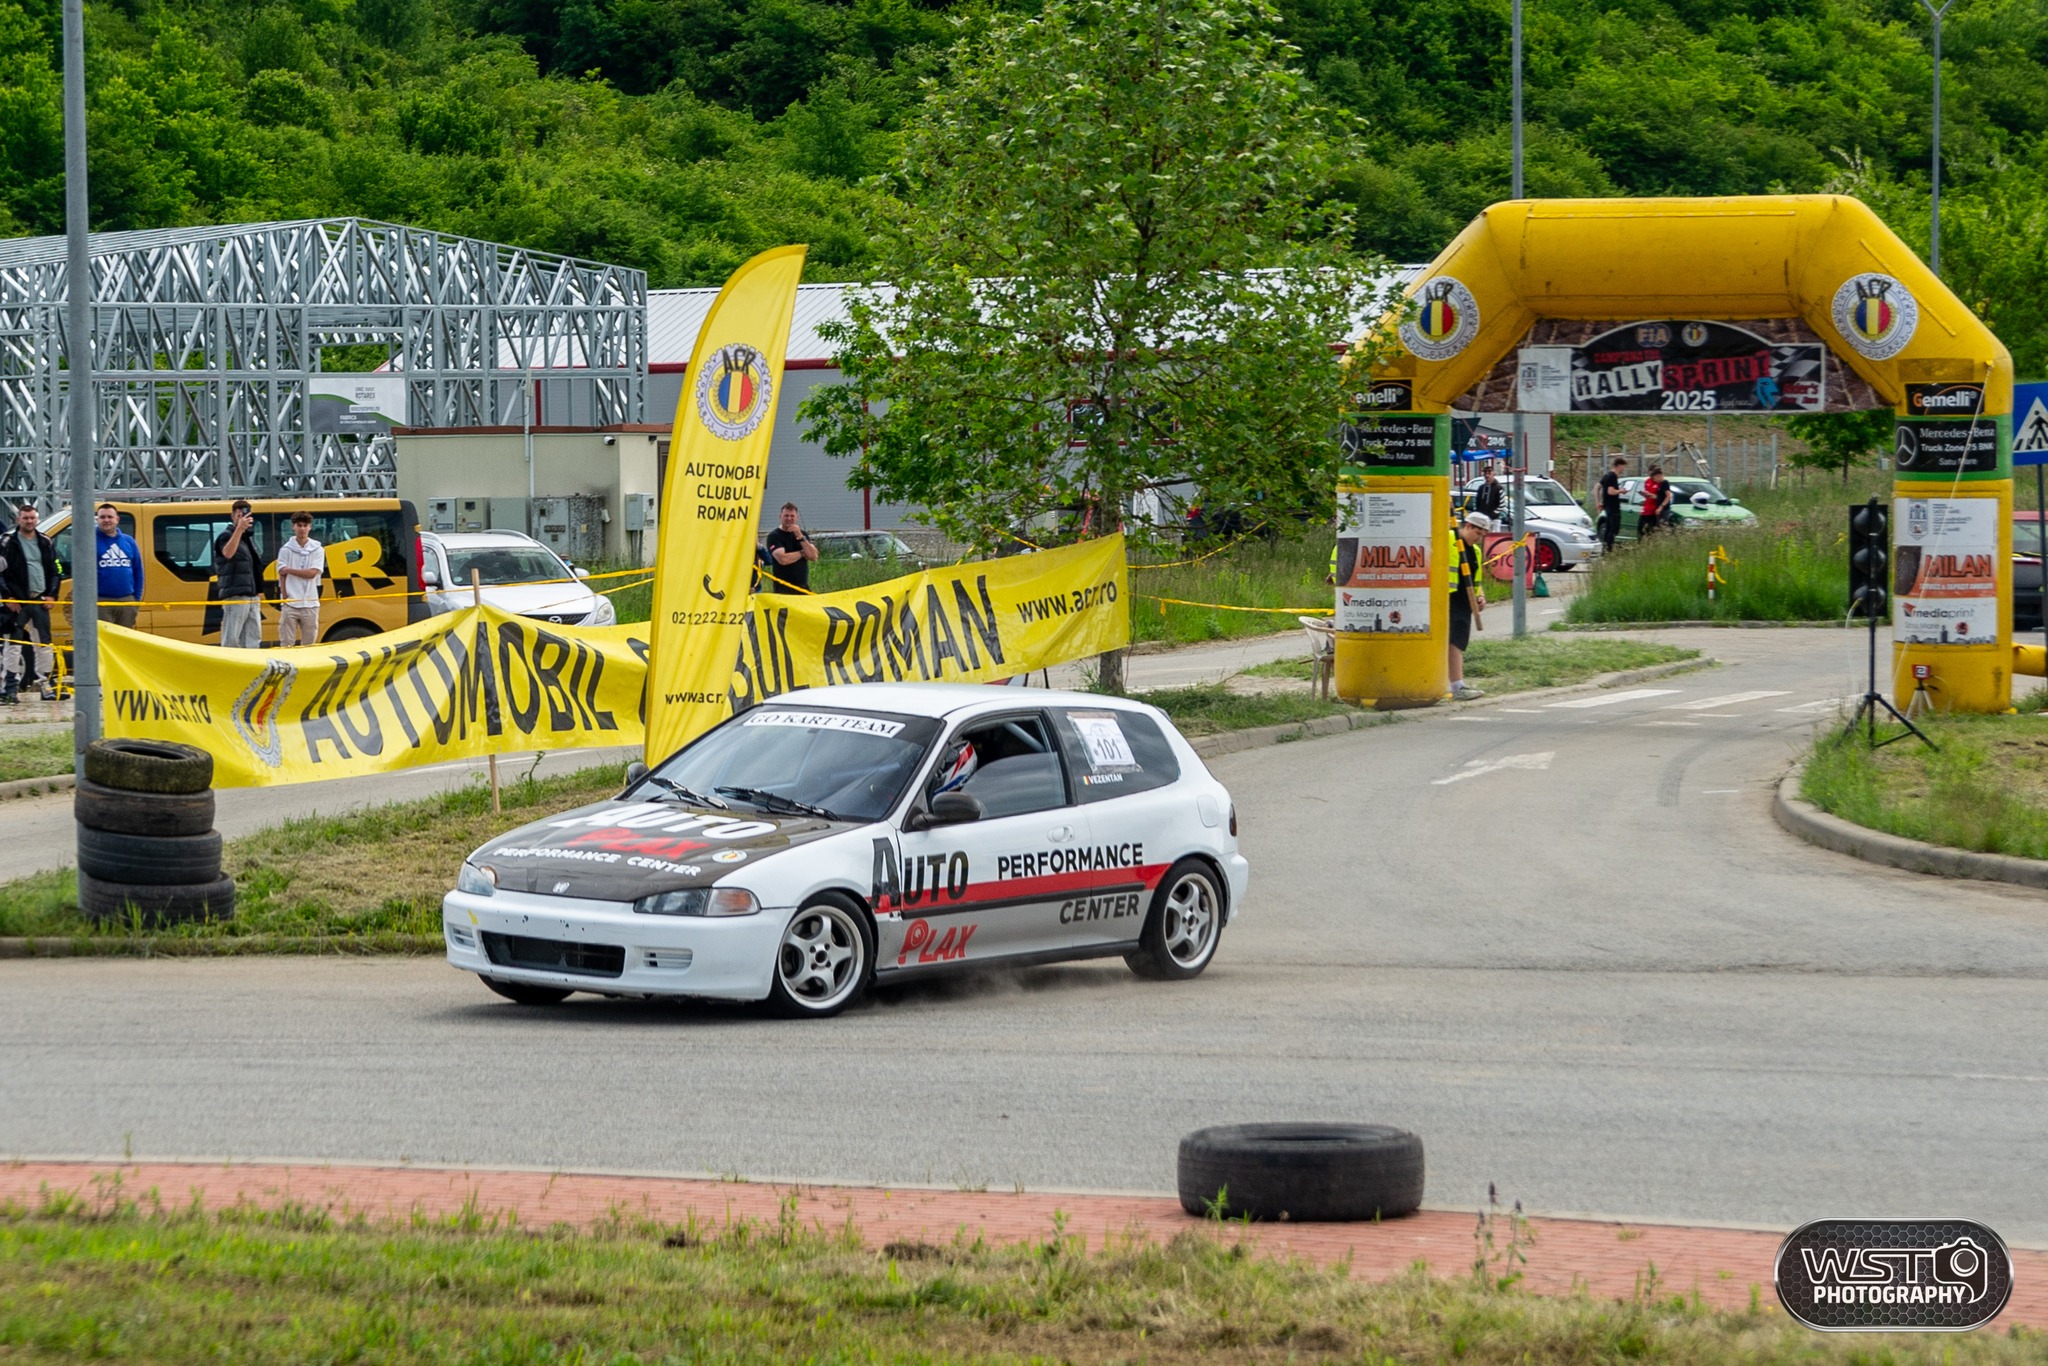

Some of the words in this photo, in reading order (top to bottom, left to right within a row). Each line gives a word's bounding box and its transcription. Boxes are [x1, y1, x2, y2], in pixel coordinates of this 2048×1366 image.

[722, 349, 756, 375] ACR
[1661, 391, 1716, 410] 2025
[1384, 439, 1404, 447] Zone
[1405, 439, 1416, 447] 75
[1920, 427, 1995, 438] Mercedes-Benz
[1396, 452, 1416, 460] Mare
[1921, 444, 1942, 452] Truck
[1944, 444, 1964, 452] Zone
[697, 484, 752, 501] CLUBUL
[697, 505, 748, 521] ROMAN
[99, 558, 131, 568] adidas
[1361, 545, 1425, 568] MILAN
[1923, 554, 1992, 577] MILAN
[1350, 597, 1407, 609] mediaprint
[300, 621, 619, 764] AUTOMOBIL
[823, 575, 1005, 686] ROMAN
[751, 714, 779, 724] GO
[784, 714, 837, 726] KART
[840, 718, 897, 735] TEAM
[1097, 738, 1122, 760] 101
[547, 802, 778, 840] AUTO
[493, 847, 622, 864] PERFORMANCE
[627, 856, 702, 877] CENTER
[869, 837, 970, 910] AUTO
[997, 842, 1144, 880] PERFORMANCE
[897, 917, 978, 965] PLAX
[1059, 893, 1140, 925] CENTER
